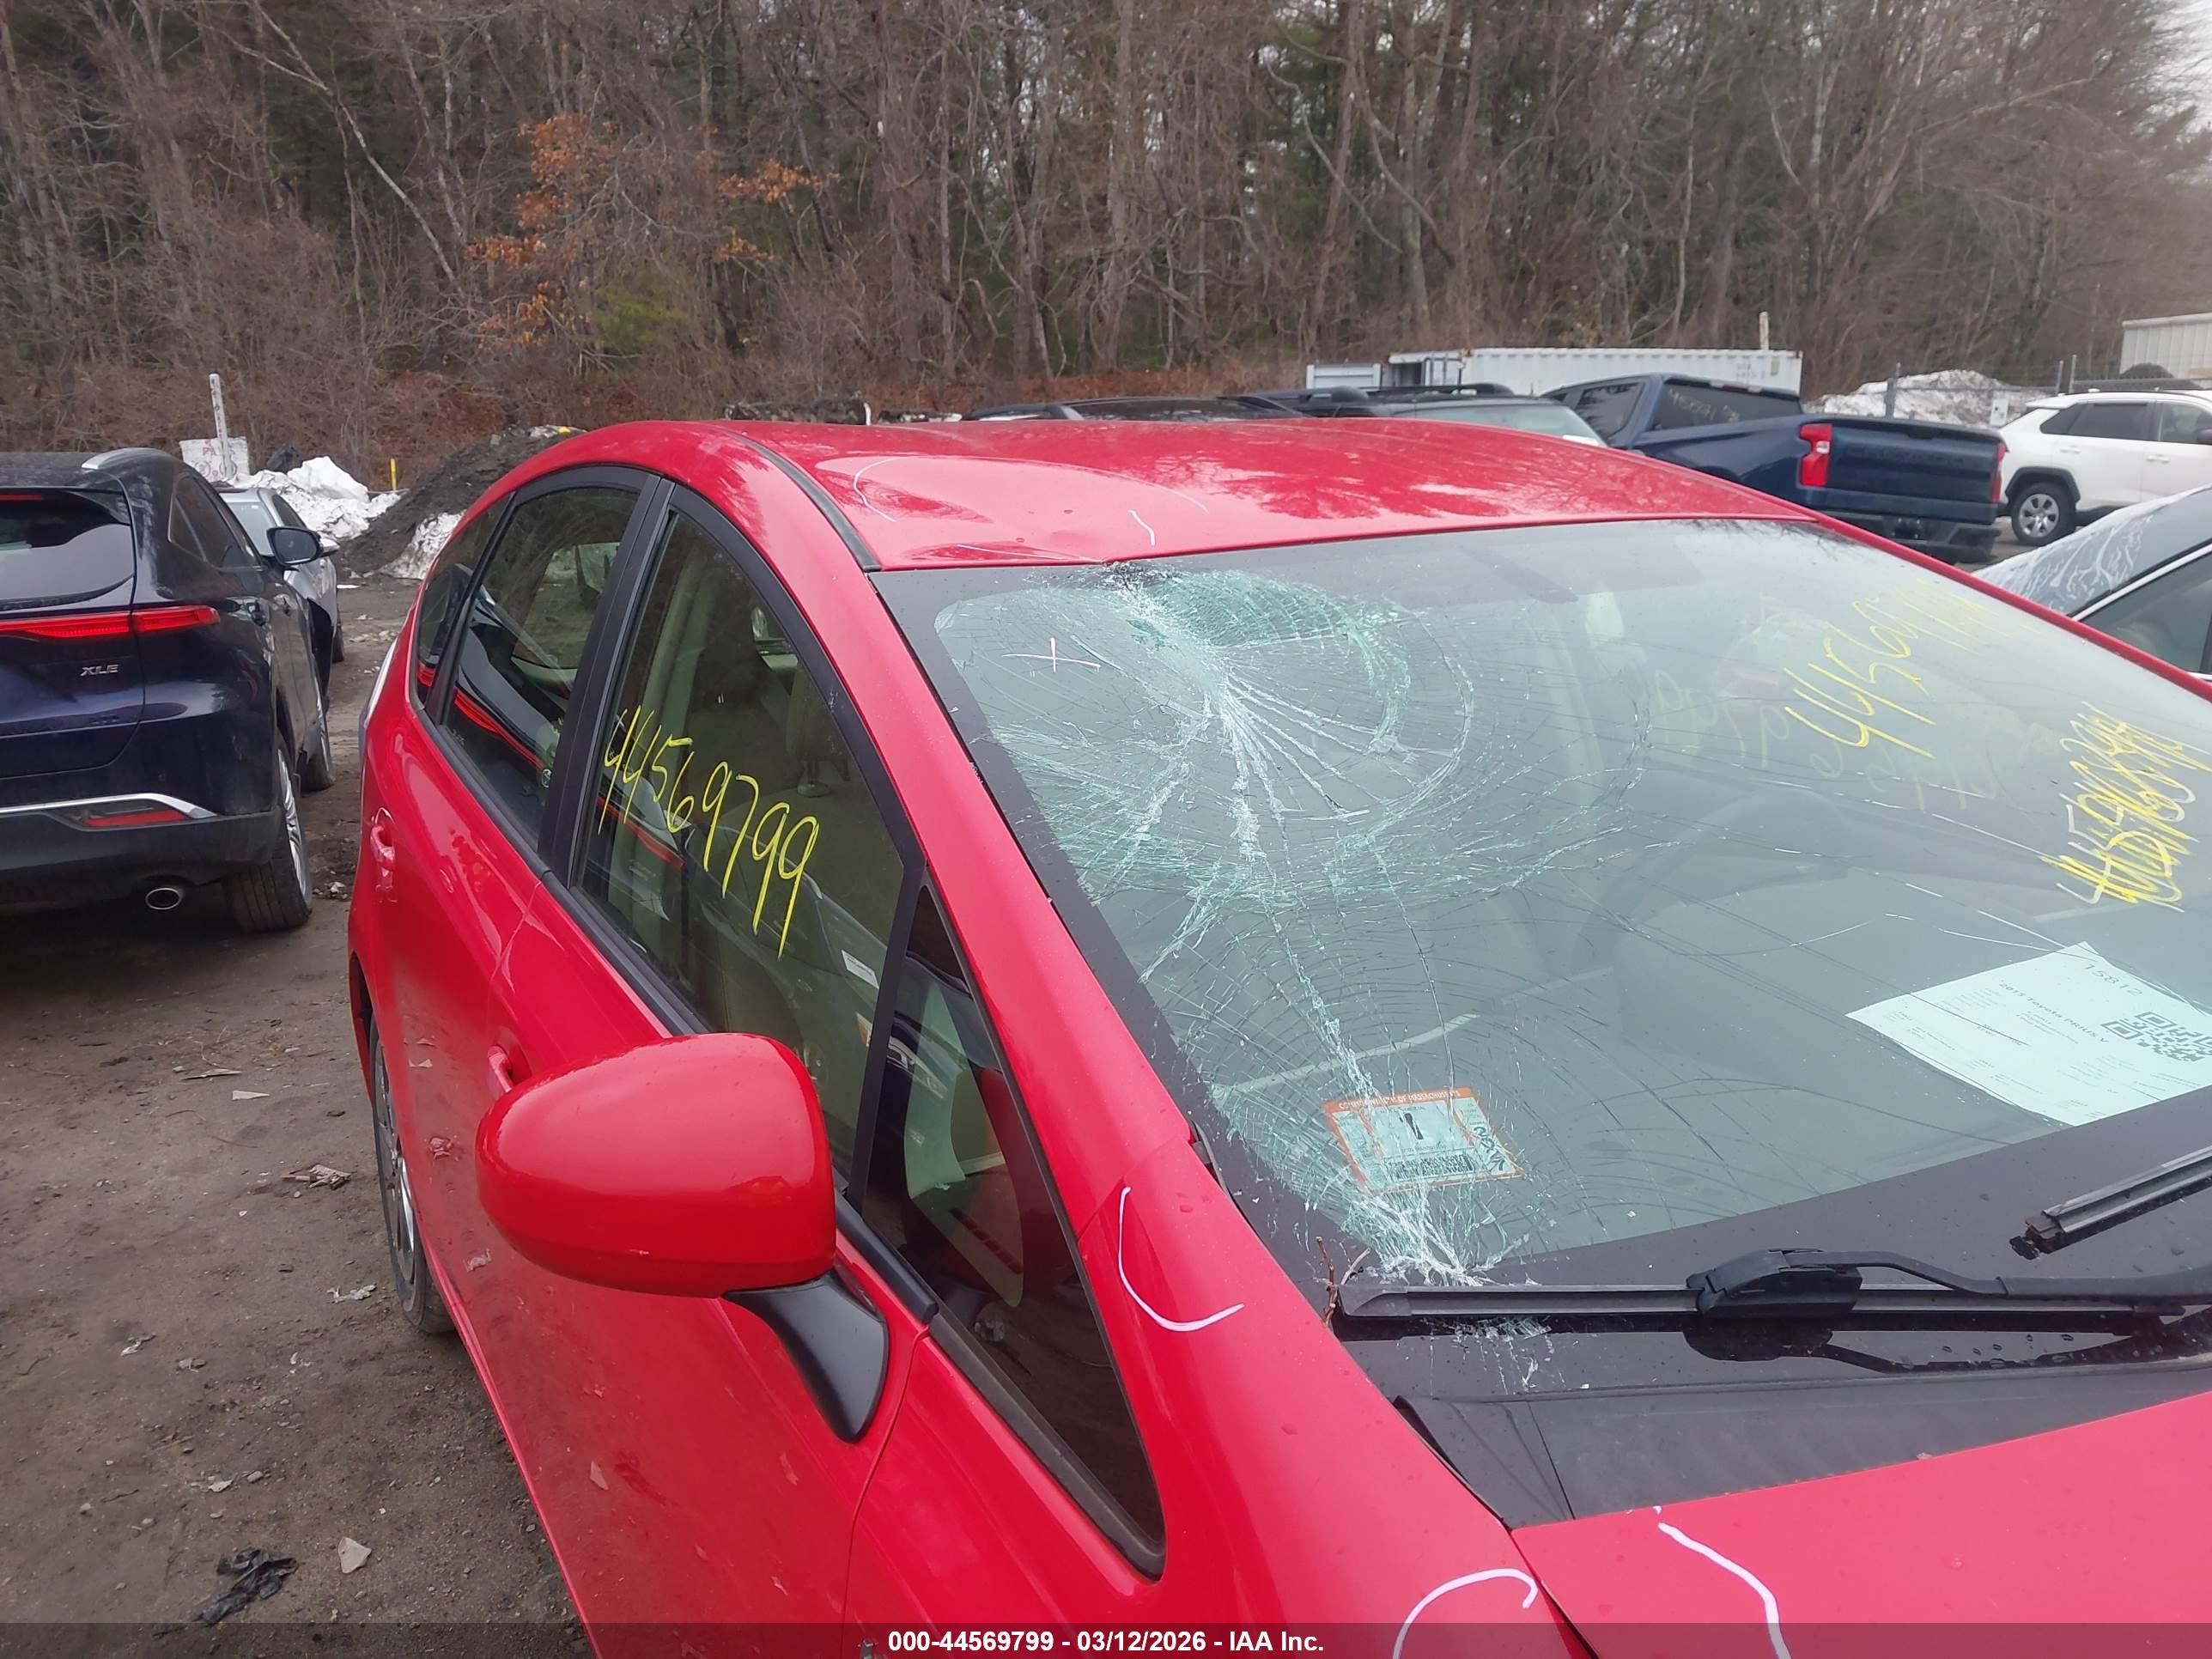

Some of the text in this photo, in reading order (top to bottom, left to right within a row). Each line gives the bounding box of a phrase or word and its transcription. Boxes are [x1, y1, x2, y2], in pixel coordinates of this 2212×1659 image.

[80, 664, 118, 677] XLE
[597, 704, 820, 963] 44569799
[2082, 963, 2144, 997] 15812
[2027, 995, 2063, 1019] Toyota
